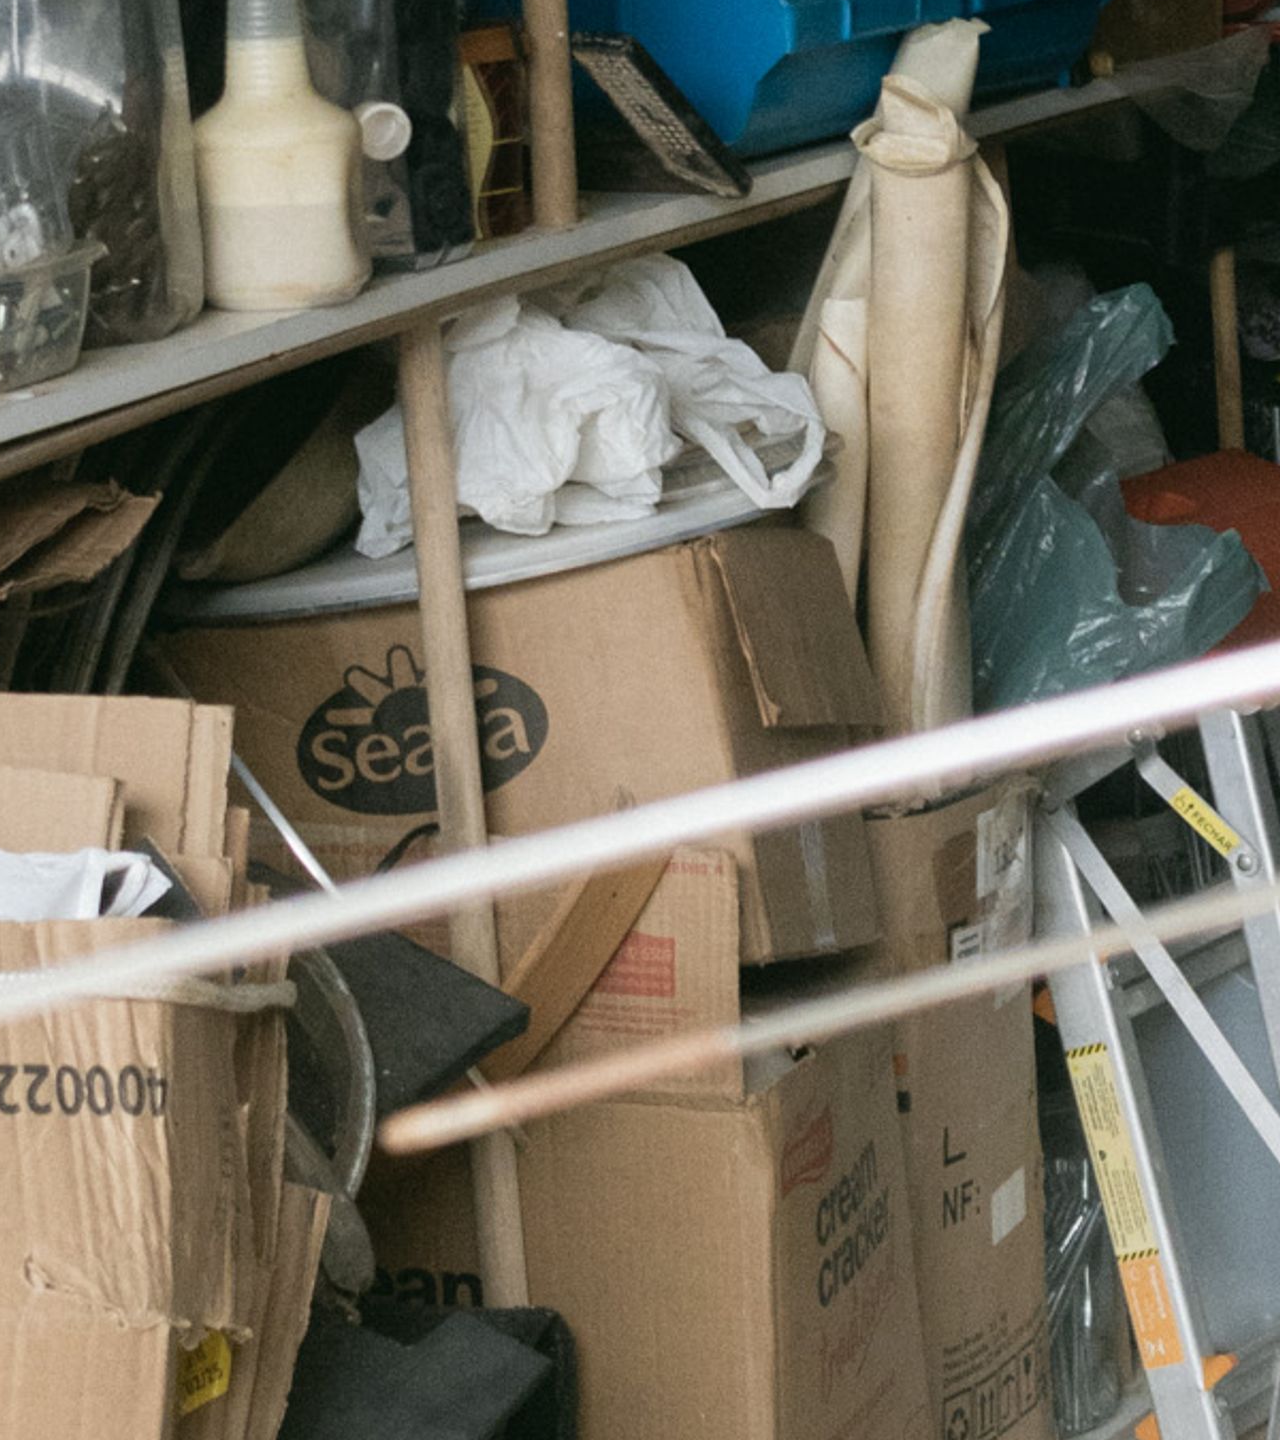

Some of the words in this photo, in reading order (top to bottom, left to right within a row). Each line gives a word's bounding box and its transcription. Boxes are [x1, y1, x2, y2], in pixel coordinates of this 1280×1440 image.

[310, 698, 530, 791] seaa
[1191, 811, 1234, 853] FECHAR
[942, 1179, 981, 1229] NF:
[818, 1186, 889, 1308] cracker
